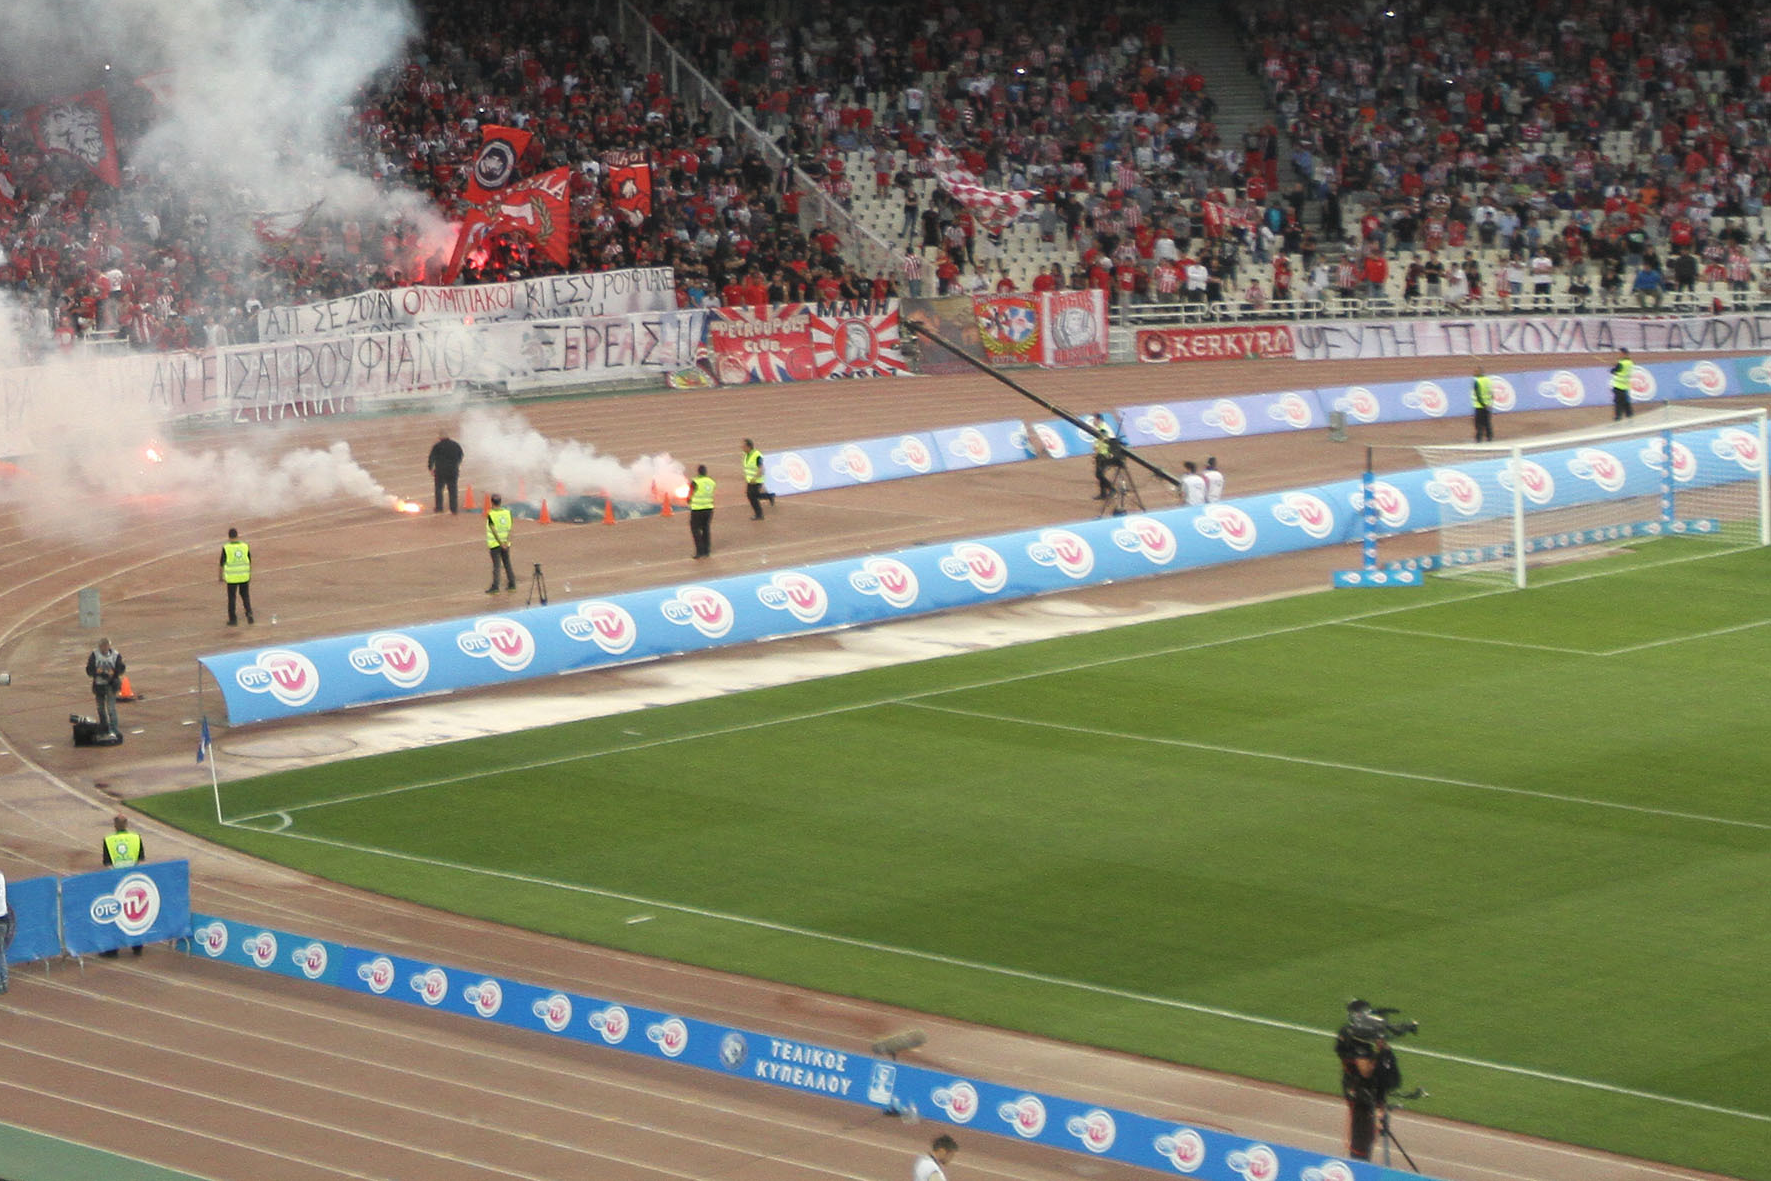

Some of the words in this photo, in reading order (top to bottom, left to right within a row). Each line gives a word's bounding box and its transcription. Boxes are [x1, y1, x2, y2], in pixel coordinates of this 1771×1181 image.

[403, 284, 515, 316] ΟΛΥΜΠΙΑΚΟΙ
[1172, 328, 1292, 358] KERKYRA
[490, 631, 521, 651] TV
[382, 647, 414, 668] TV
[271, 664, 303, 685] TV
[95, 904, 118, 917] OTE
[121, 894, 149, 917] TV
[771, 1039, 848, 1072] ΤΕΛΙΚΟΣ
[756, 1059, 853, 1096] ΚΥΠΕΛΛΟΥ
